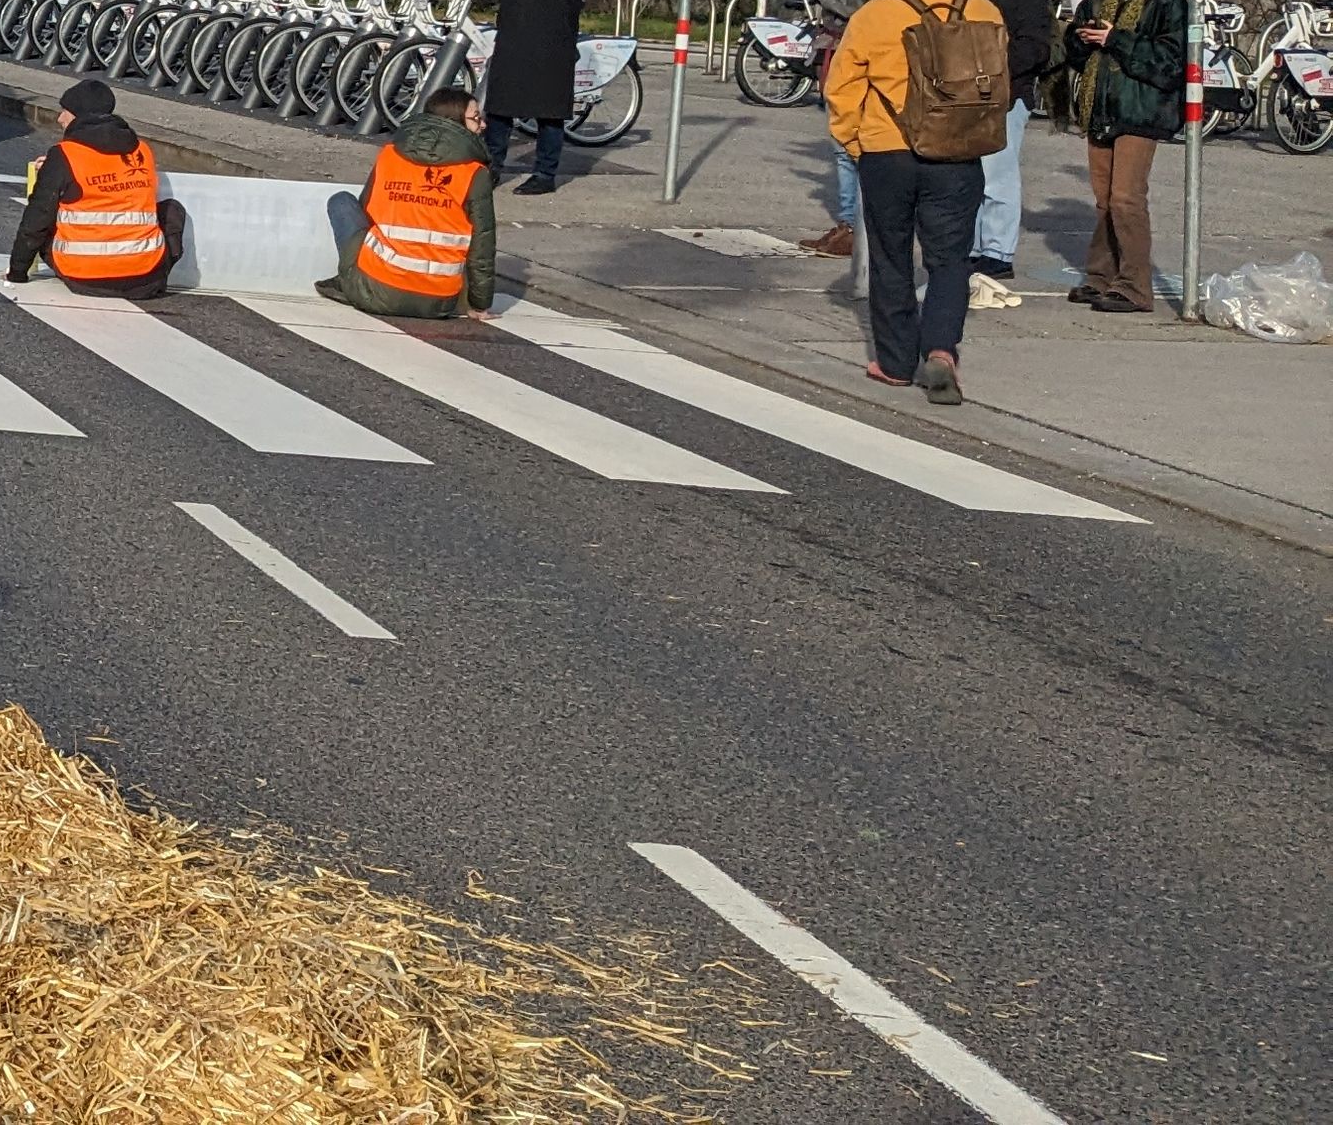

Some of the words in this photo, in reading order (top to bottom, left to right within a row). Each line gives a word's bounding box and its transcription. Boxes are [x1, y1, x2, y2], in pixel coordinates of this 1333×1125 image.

[86, 172, 118, 186] LETZTE
[383, 180, 413, 191] LETZTE
[388, 191, 454, 210] GENERATION.AT
